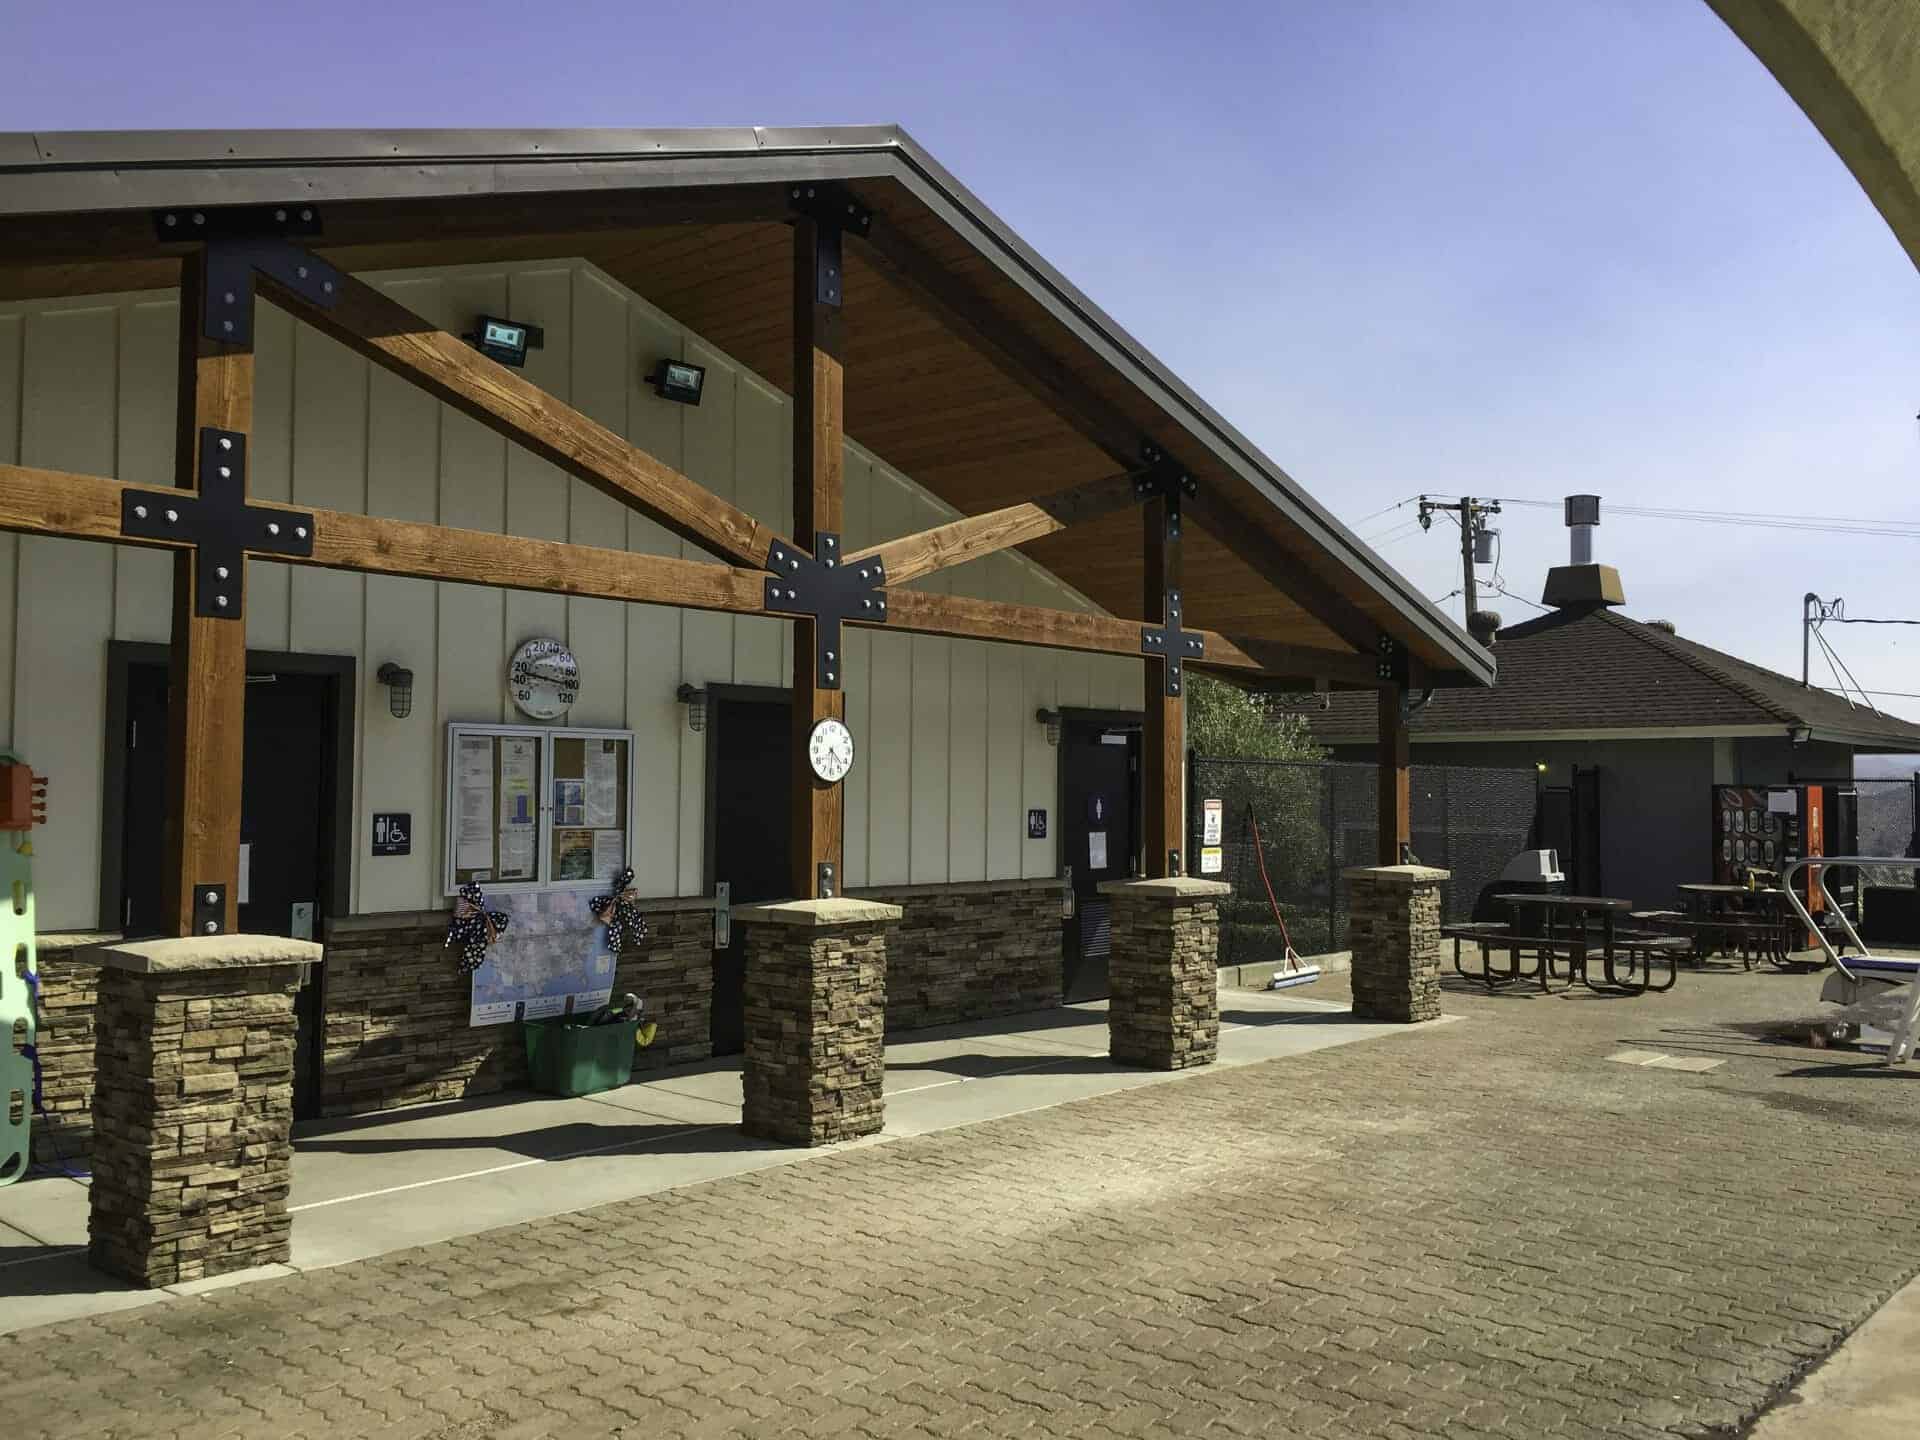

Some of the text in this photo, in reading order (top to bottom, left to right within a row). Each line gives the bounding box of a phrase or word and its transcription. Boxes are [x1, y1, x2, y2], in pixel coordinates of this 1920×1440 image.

[534, 642, 546, 652] 20
[547, 643, 560, 653] 40
[525, 648, 531, 658] 0
[559, 652, 572, 662] 60
[565, 667, 577, 676] 80
[564, 679, 579, 689] 100
[558, 692, 574, 704] 120
[815, 735, 823, 744] 10
[842, 736, 849, 744] 2
